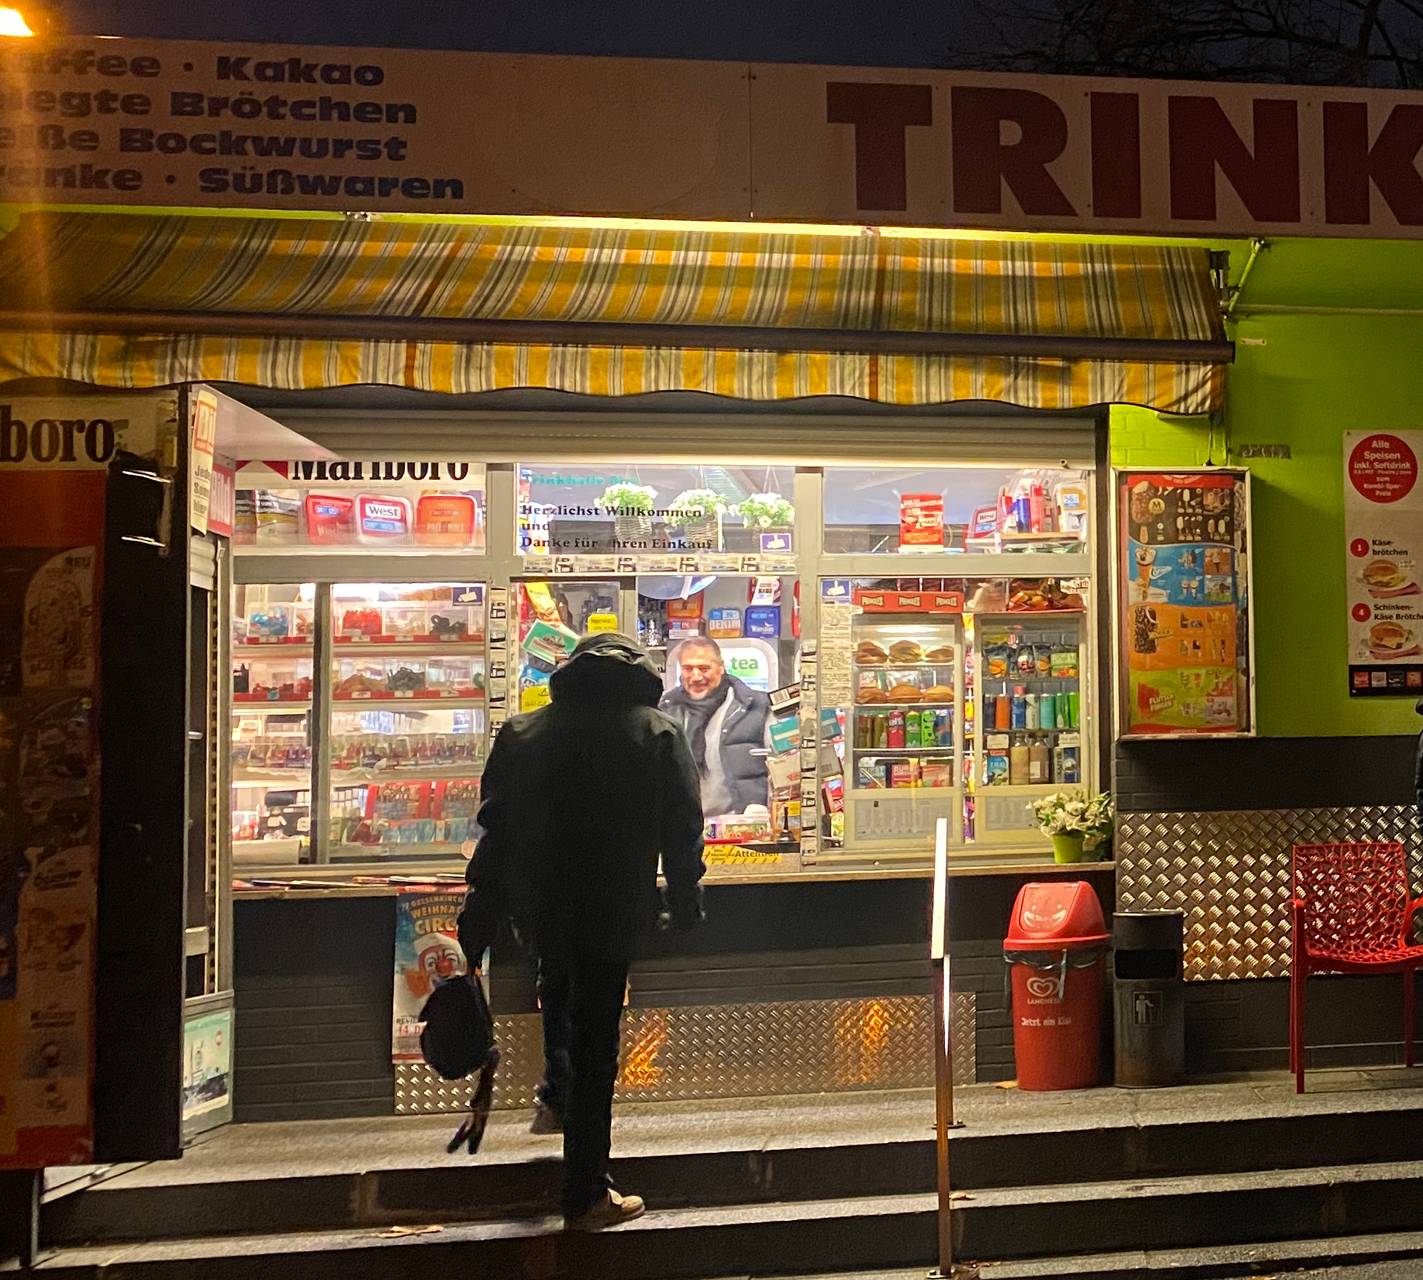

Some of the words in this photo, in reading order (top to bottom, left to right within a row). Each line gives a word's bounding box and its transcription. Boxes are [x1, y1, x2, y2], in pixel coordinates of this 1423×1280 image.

[0, 50, 160, 78] affee
[217, 56, 384, 86] Kakao
[0, 90, 152, 118] legte
[170, 91, 417, 124] Brötchen
[120, 128, 407, 161] Bockwurst
[0, 164, 143, 191] änke
[199, 166, 464, 199] Süßwaren
[0, 404, 116, 463] boro
[1371, 440, 1390, 449] Alle
[1364, 451, 1400, 460] Speisen
[1373, 461, 1411, 469] Softdrink
[368, 505, 399, 517] West
[522, 505, 600, 516] Herzlichst
[605, 505, 702, 517] Willkommen
[522, 521, 550, 531] und
[522, 537, 570, 548] Danke
[575, 537, 599, 548] für
[607, 538, 648, 549] hren
[652, 539, 713, 549] Einkauf
[1372, 548, 1408, 556] brötchen
[1373, 603, 1414, 611] Schinken-
[1374, 612, 1394, 621] Käse
[730, 656, 759, 670] tea
[411, 904, 464, 919] WEIHNAC
[415, 917, 457, 936] CIRC
